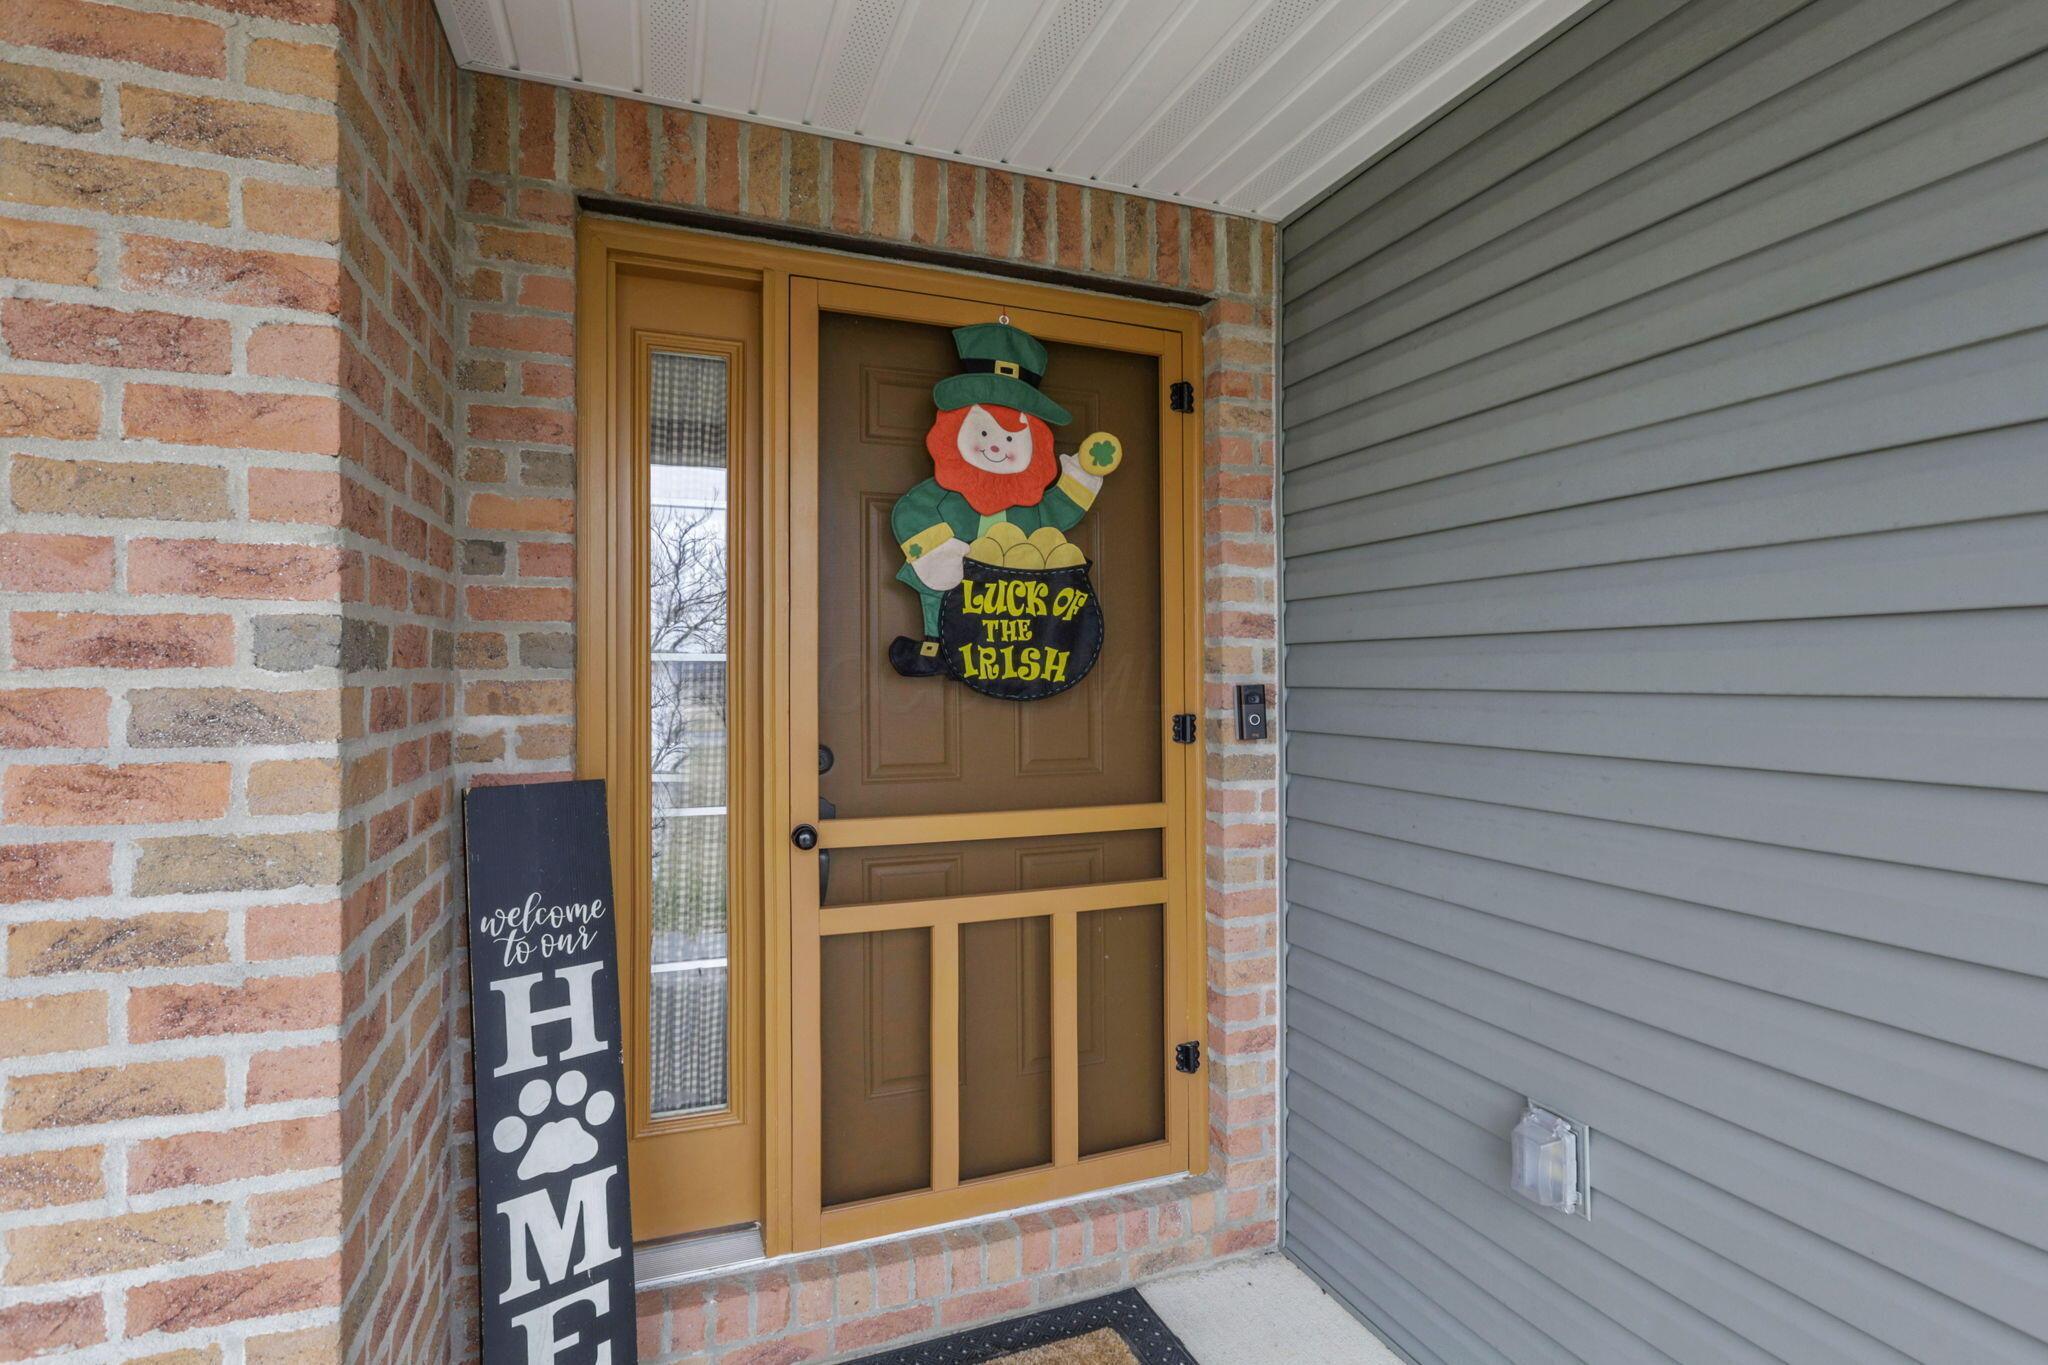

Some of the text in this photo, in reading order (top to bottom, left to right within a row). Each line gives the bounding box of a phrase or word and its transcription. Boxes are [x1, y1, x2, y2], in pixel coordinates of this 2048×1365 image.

[961, 579, 1089, 621] LUCK OF
[982, 619, 1033, 643] THE
[958, 642, 1071, 683] IRISH
[480, 892, 606, 938] welcome
[492, 925, 598, 967] to our
